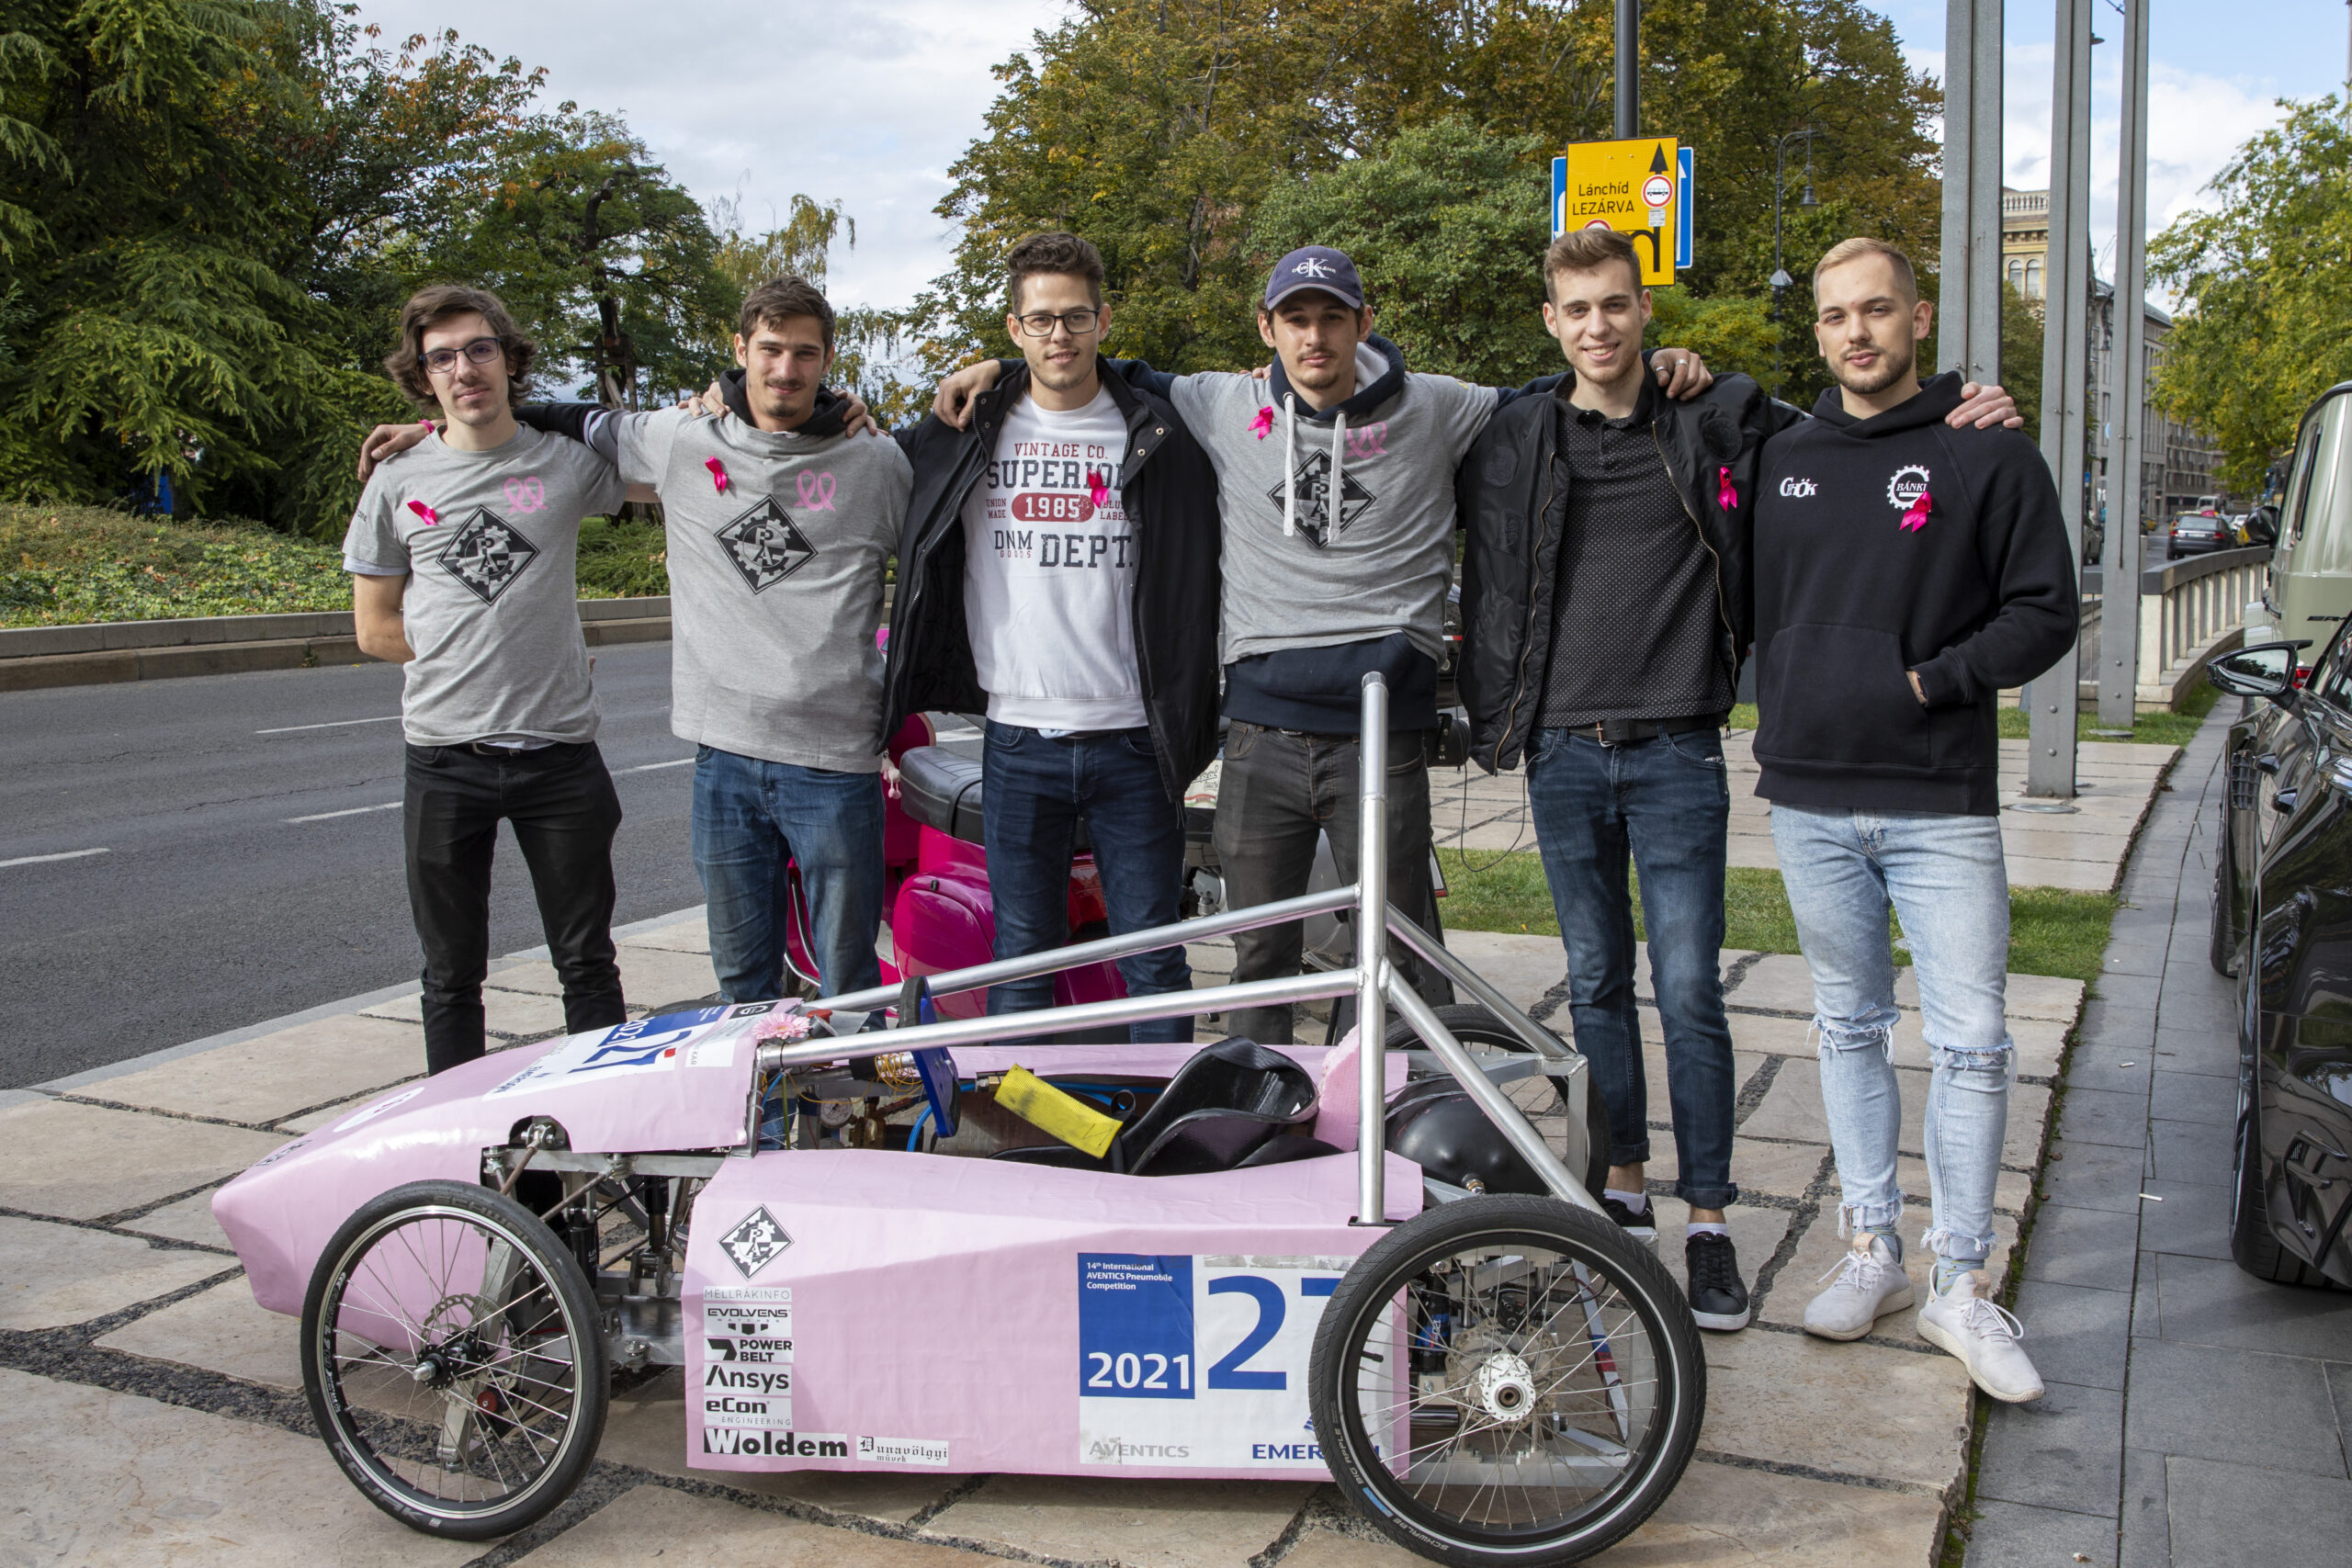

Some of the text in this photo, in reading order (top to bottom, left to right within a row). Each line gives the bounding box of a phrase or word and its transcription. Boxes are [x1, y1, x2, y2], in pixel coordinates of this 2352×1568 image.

[1578, 181, 1629, 197] Lánchíd
[1572, 198, 1634, 216] LEZÁRVA
[1014, 443, 1108, 459] VINTAGE CO.
[1895, 480, 1928, 492] BÁNKI
[986, 499, 1007, 507] UNION
[1024, 497, 1080, 518] 1985
[1102, 501, 1124, 509] BLU
[988, 510, 1007, 519] MADE
[994, 531, 1133, 568] DNM DEPT.
[1000, 550, 1031, 558] GOODS
[1102, 1262, 1154, 1270] International
[1087, 1272, 1173, 1282] AVENTICS Pneumobile
[1087, 1281, 1136, 1291] Competition
[704, 1288, 790, 1300] MELLRÁKINFO
[707, 1308, 788, 1317] EVOLVENS
[740, 1340, 792, 1350] POWER
[740, 1352, 775, 1362] BELT
[1088, 1352, 1190, 1390] 2021
[706, 1365, 789, 1393] Ansys
[721, 1416, 791, 1426] ENGINEERING
[704, 1427, 947, 1461] Woldem Dunavölgyi
[1089, 1441, 1191, 1459] AVENTICS
